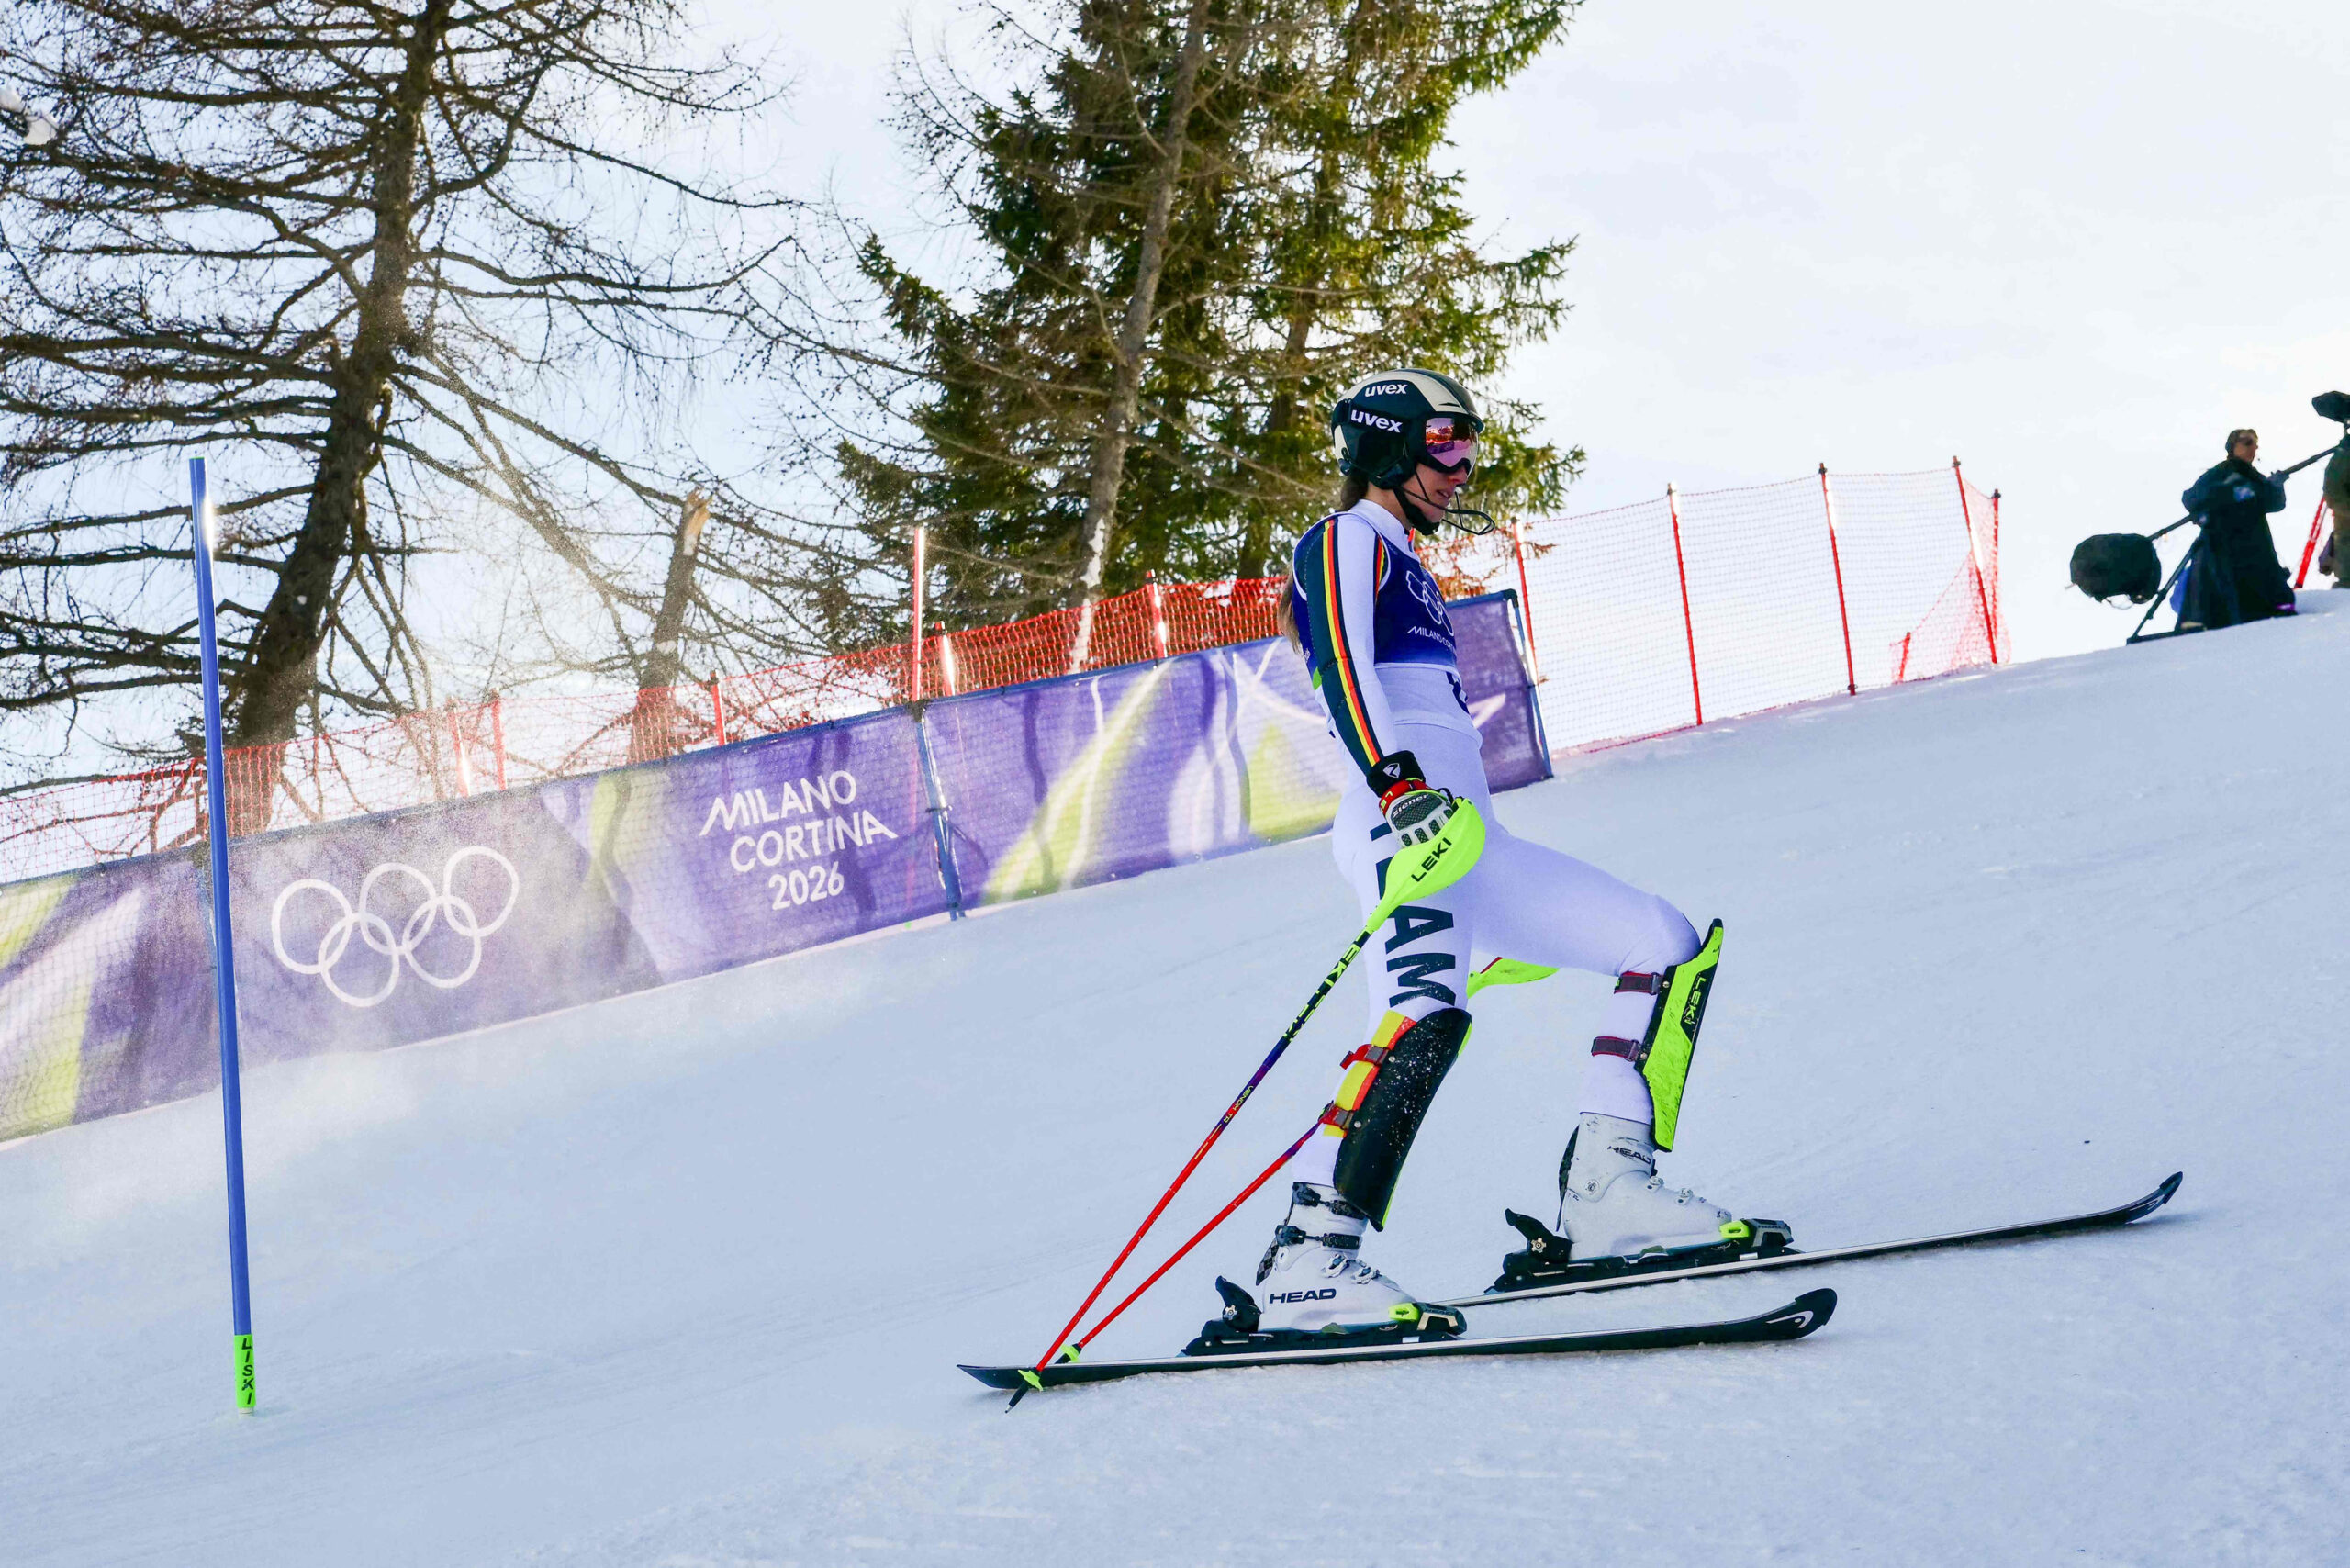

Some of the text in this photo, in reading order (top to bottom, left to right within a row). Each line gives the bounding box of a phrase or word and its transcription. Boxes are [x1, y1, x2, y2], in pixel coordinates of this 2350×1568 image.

[1364, 384, 1408, 398] uvex
[1350, 409, 1403, 433] uvex
[1406, 625, 1442, 644] MILANO
[699, 770, 857, 837] MILANO
[730, 810, 899, 873] CORTINA
[1410, 836, 1453, 882] LEKI
[768, 861, 845, 911] 2026
[1684, 976, 1707, 1025] LEKI
[1269, 1287, 1337, 1305] HEAD
[241, 1337, 255, 1406] LISKI
